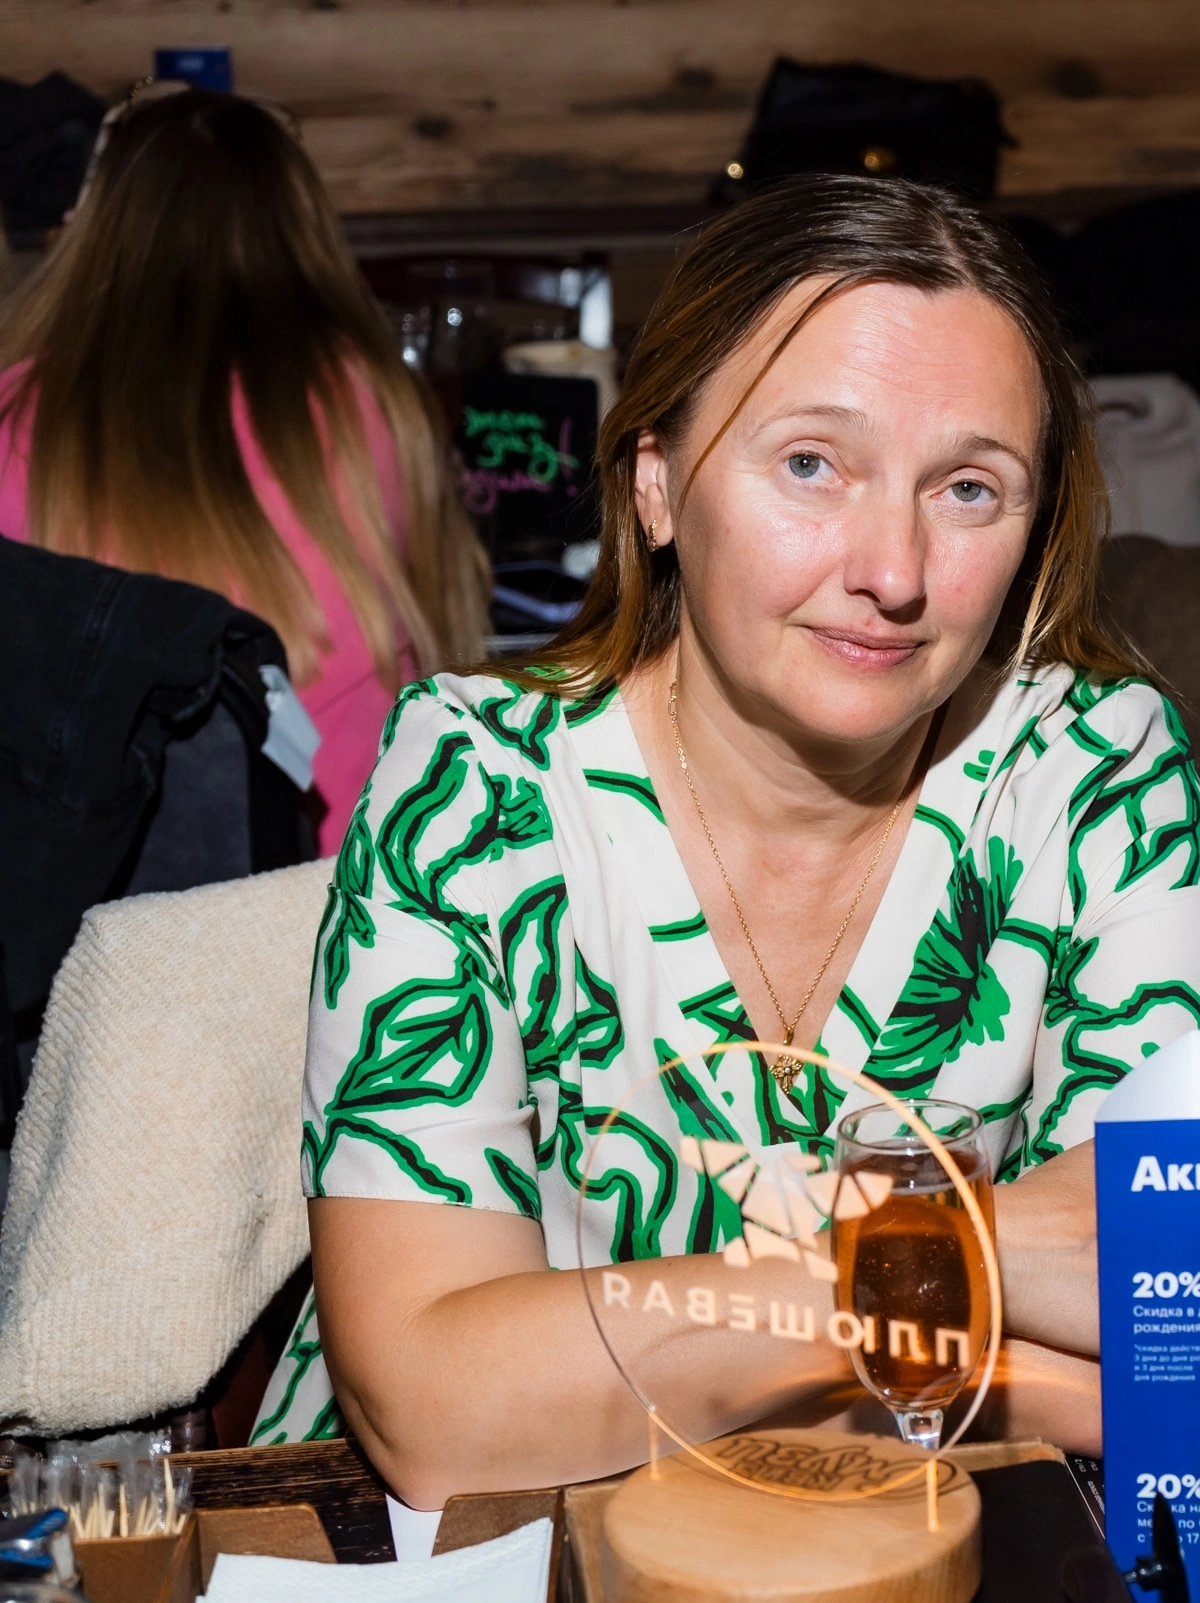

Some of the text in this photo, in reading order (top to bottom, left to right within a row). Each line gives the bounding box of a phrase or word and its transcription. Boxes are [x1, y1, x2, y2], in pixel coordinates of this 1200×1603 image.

[1133, 1305, 1184, 1318] Скидка
[1187, 1307, 1195, 1317] в
[1151, 1374, 1196, 1382] рождения
